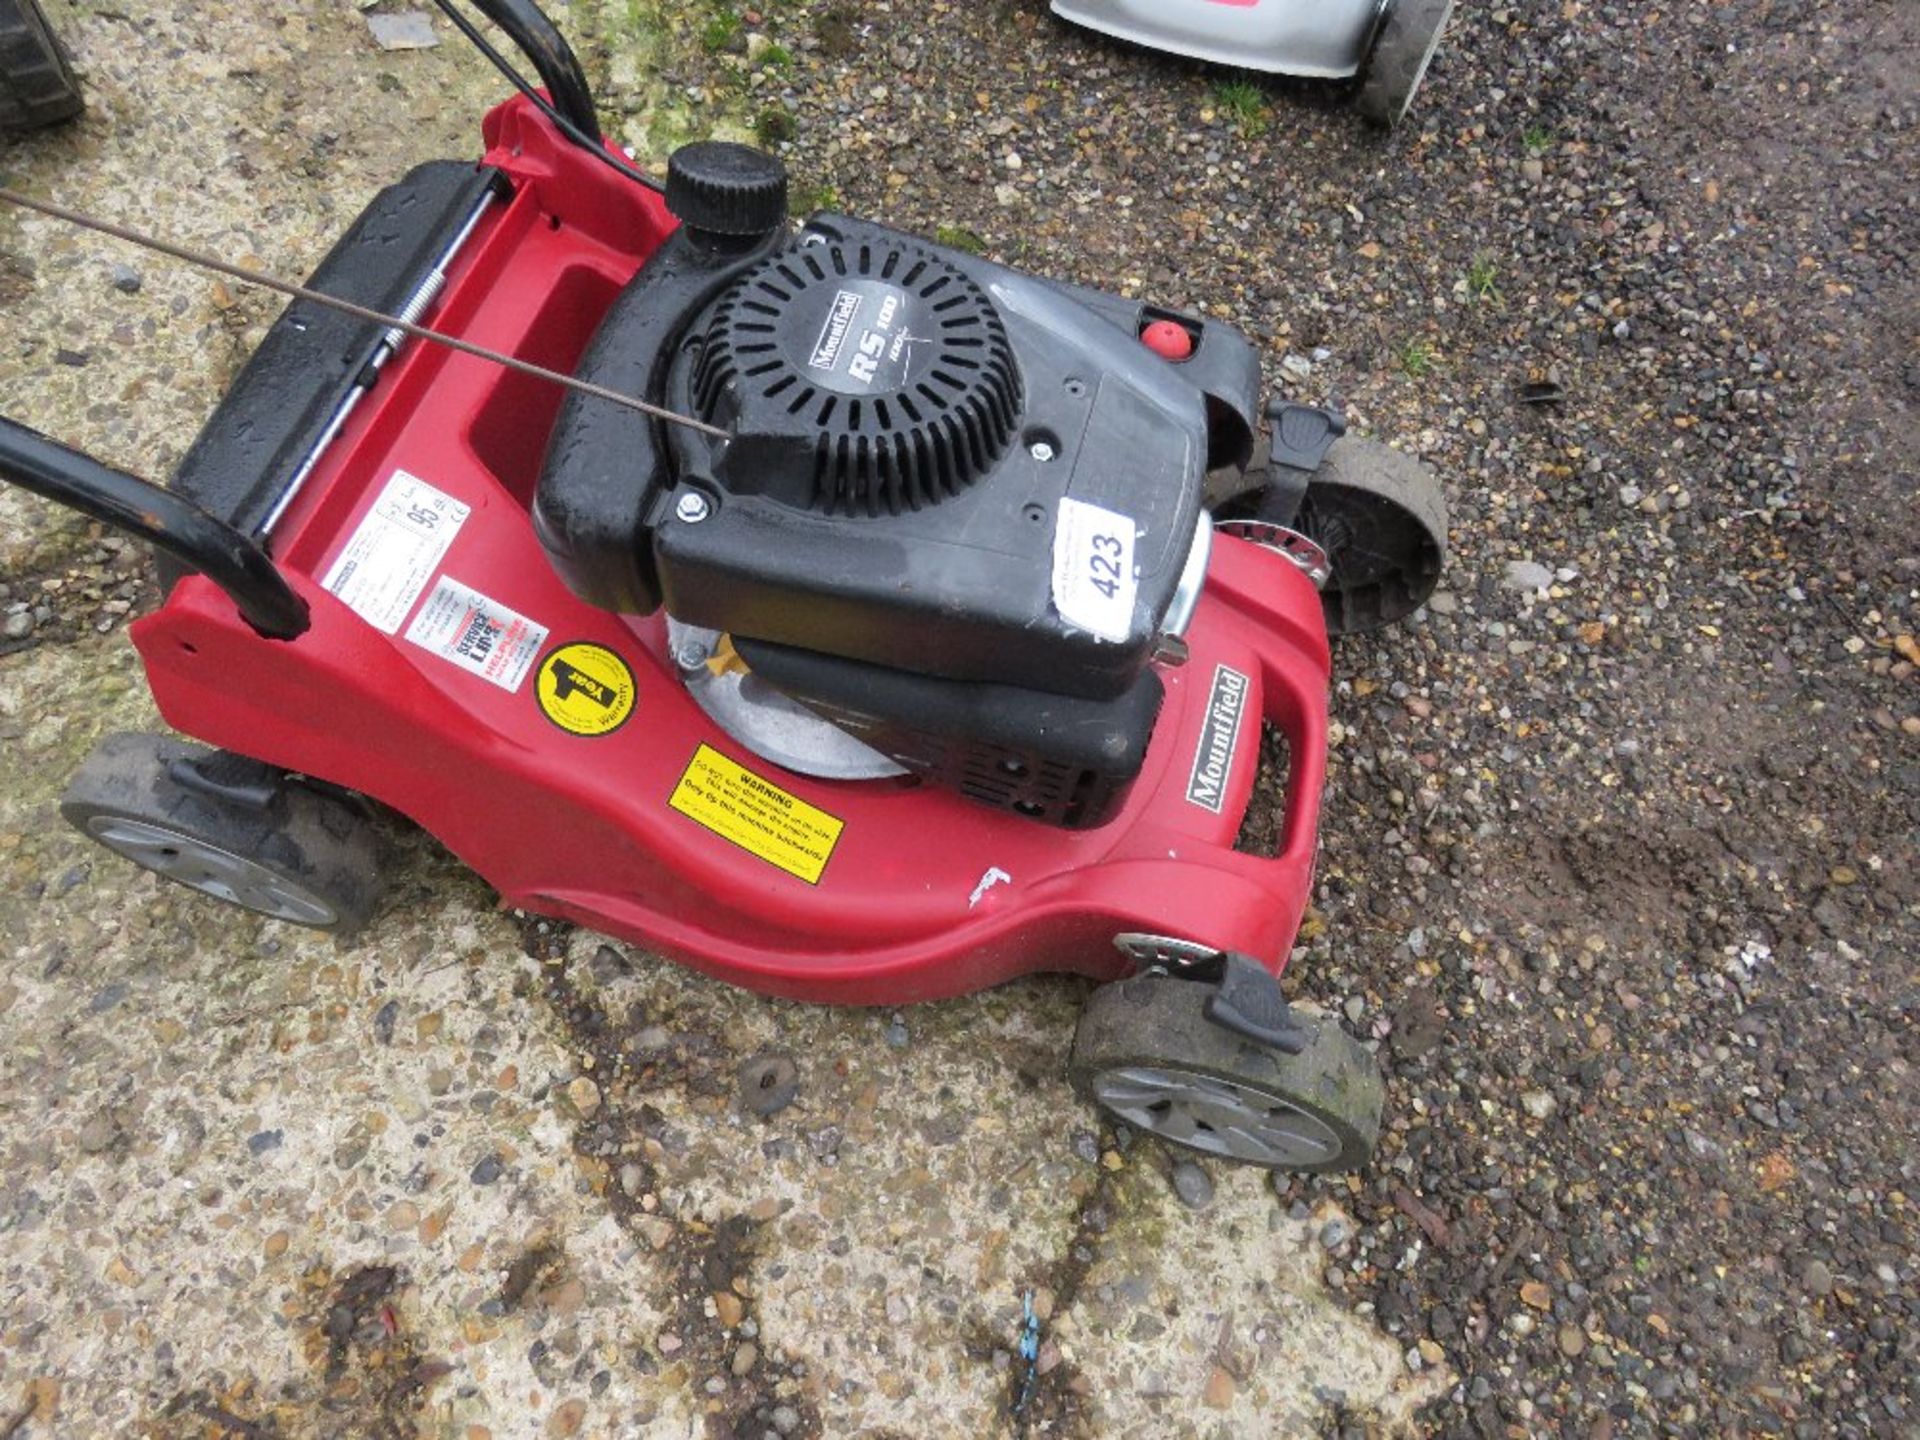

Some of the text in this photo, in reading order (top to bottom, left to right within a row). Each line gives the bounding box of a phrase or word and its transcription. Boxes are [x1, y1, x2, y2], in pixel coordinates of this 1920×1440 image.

[813, 293, 856, 368] Mountfield
[848, 295, 898, 385] RS 100
[407, 504, 439, 529] 95
[1090, 533, 1122, 600] 423
[455, 611, 489, 656] SERVICE
[551, 657, 617, 709] 1
[568, 672, 604, 701] Year
[1193, 671, 1244, 808] Mountfield
[738, 773, 794, 809] WARNING
